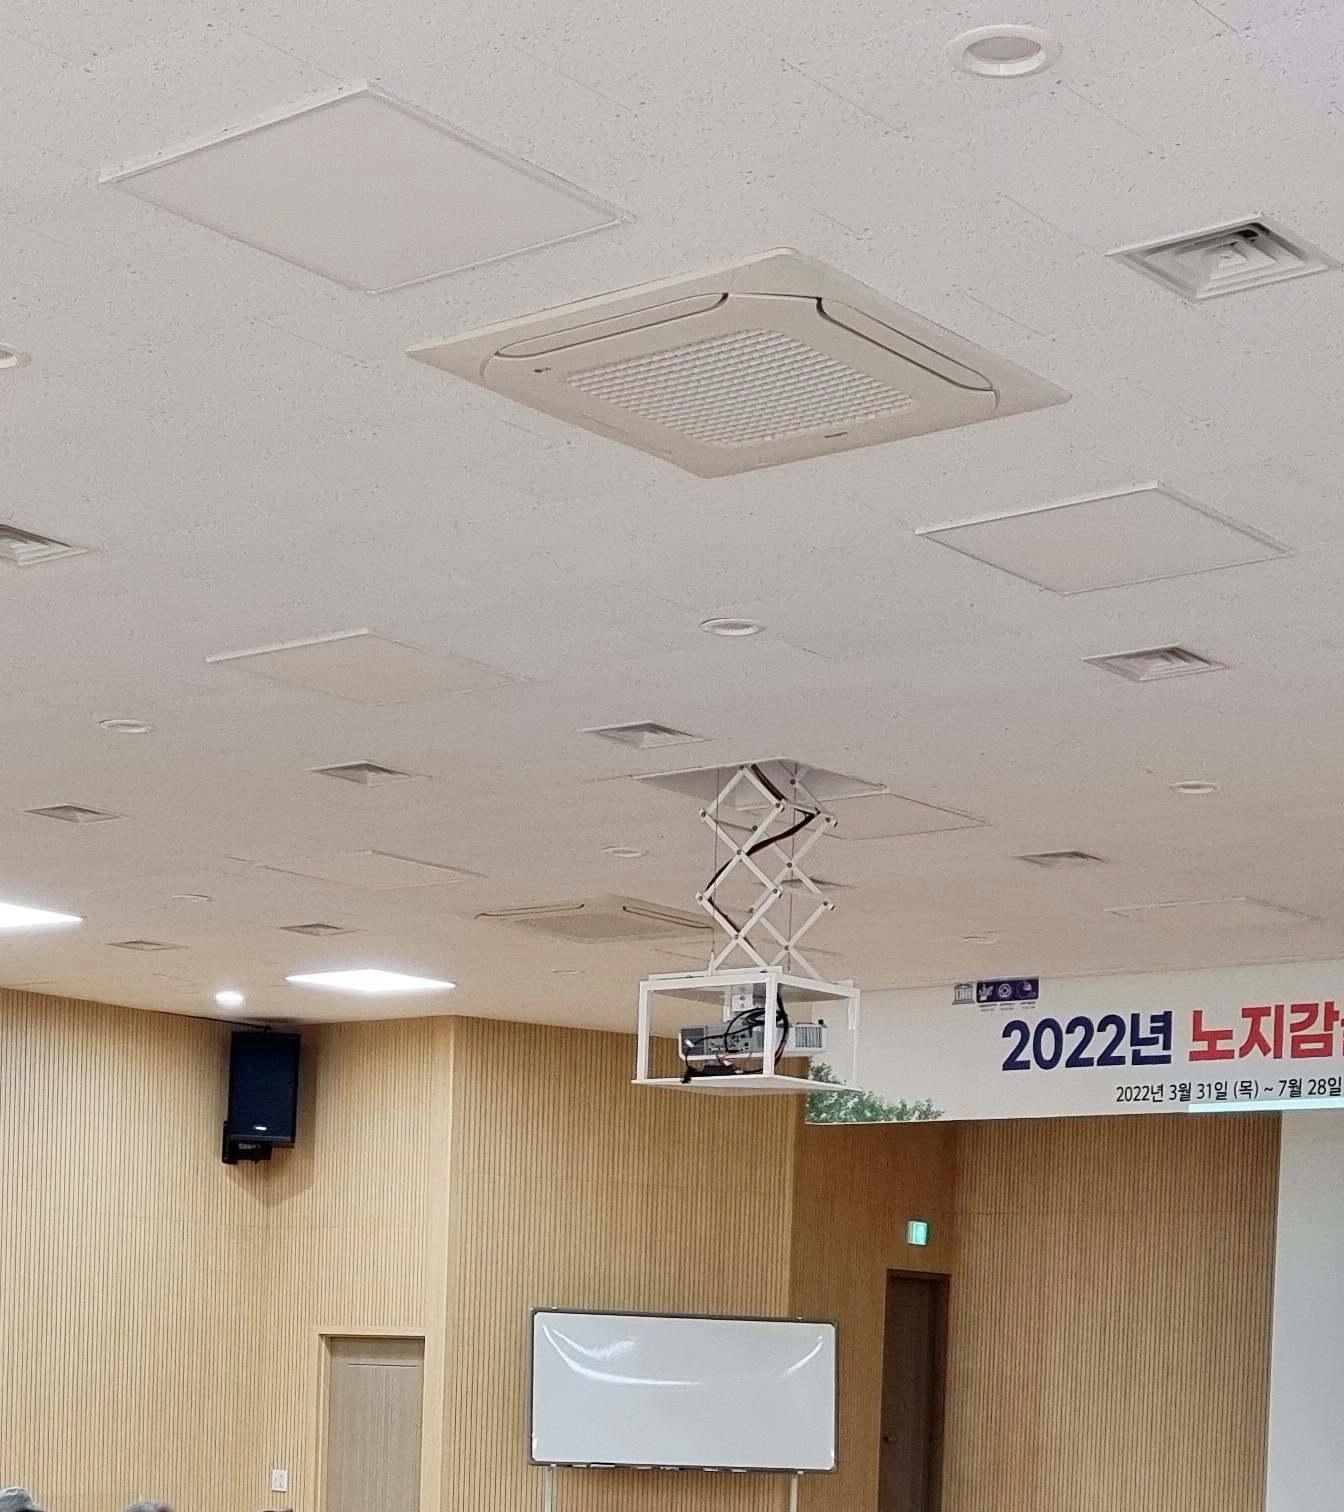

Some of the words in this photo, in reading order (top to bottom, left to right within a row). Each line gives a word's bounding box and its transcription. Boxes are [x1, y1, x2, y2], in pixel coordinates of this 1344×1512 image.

[1001, 1010, 1173, 1072] 2022년
[1116, 1083, 1164, 1103] 2022년
[1168, 1082, 1192, 1102] 3월
[1196, 1080, 1228, 1100] 31일
[1233, 1079, 1259, 1100] (목)
[1278, 1077, 1303, 1098] 7월
[1307, 1076, 1342, 1097] 28일
